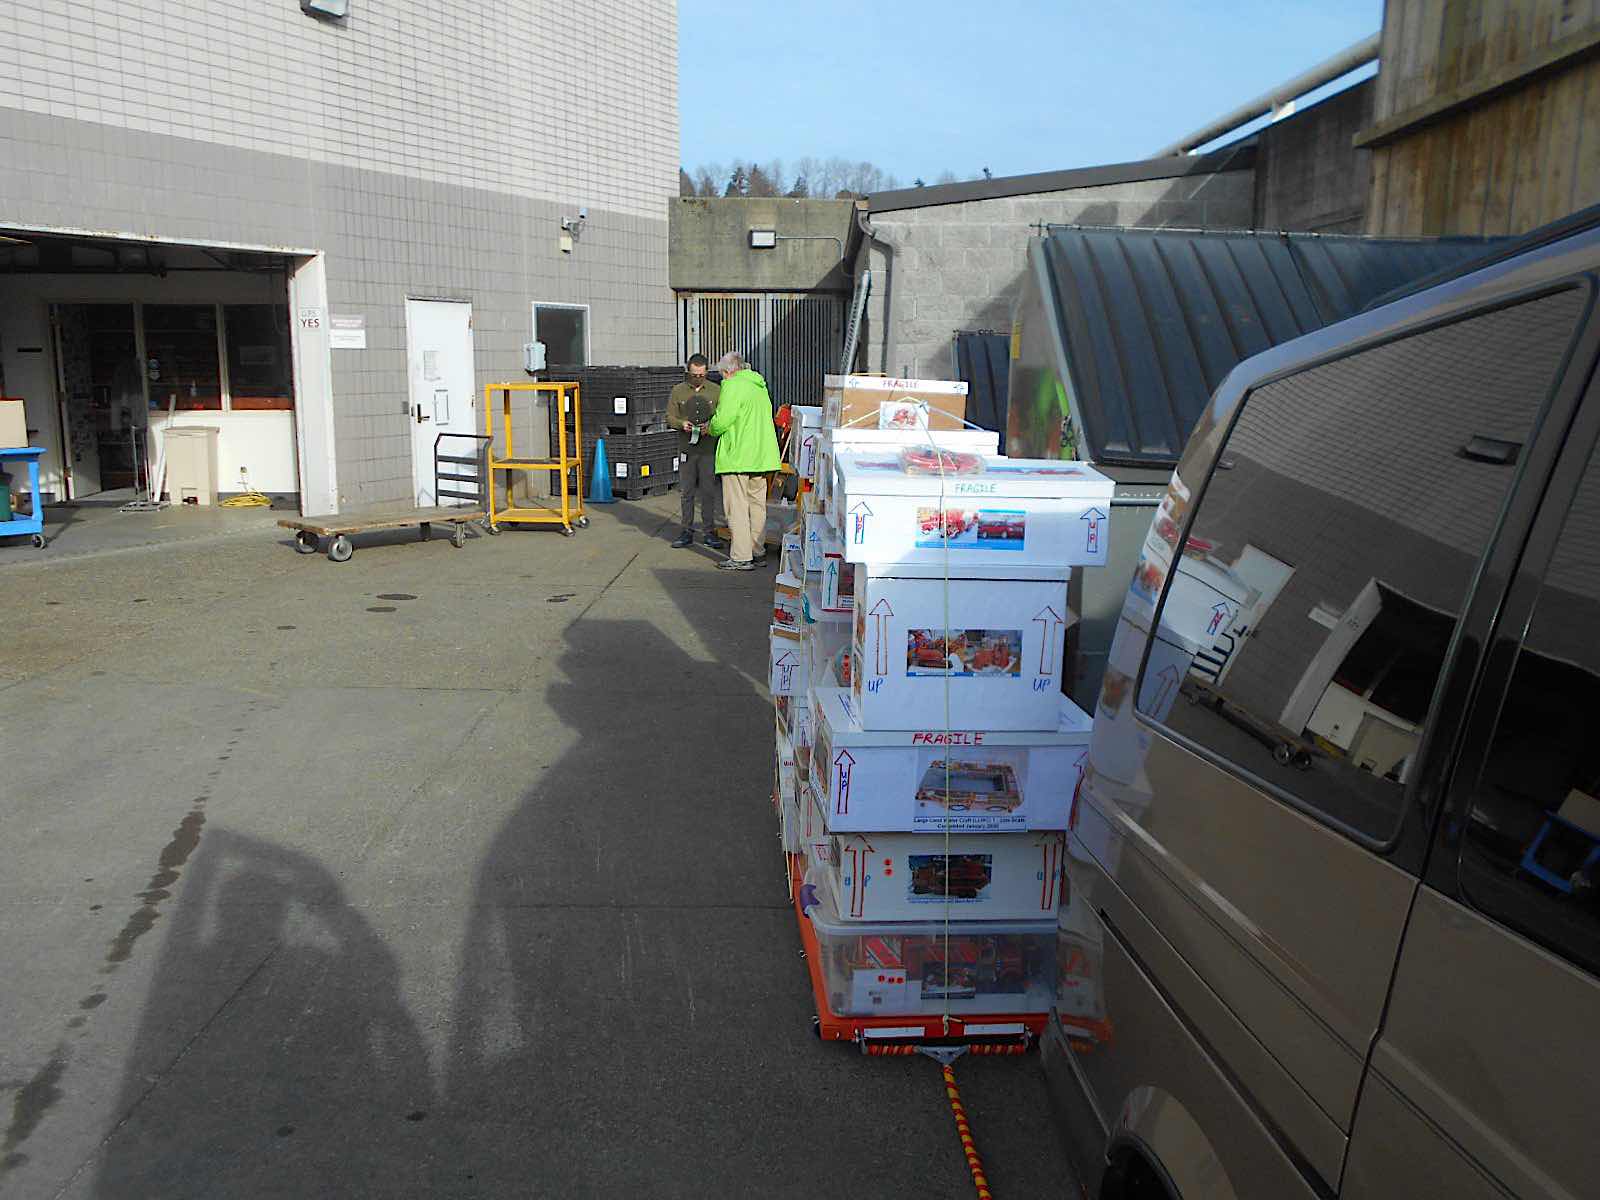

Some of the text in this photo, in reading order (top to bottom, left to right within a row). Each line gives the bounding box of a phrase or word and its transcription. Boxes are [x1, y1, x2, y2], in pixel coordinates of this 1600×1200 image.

[301, 318, 320, 328] YES
[882, 380, 918, 388] FRAGILE
[955, 483, 997, 493] FRAGILE
[868, 679, 884, 694] UP
[1033, 678, 1051, 692] UP
[912, 732, 985, 746] FRAGILE
[841, 771, 848, 790] UP
